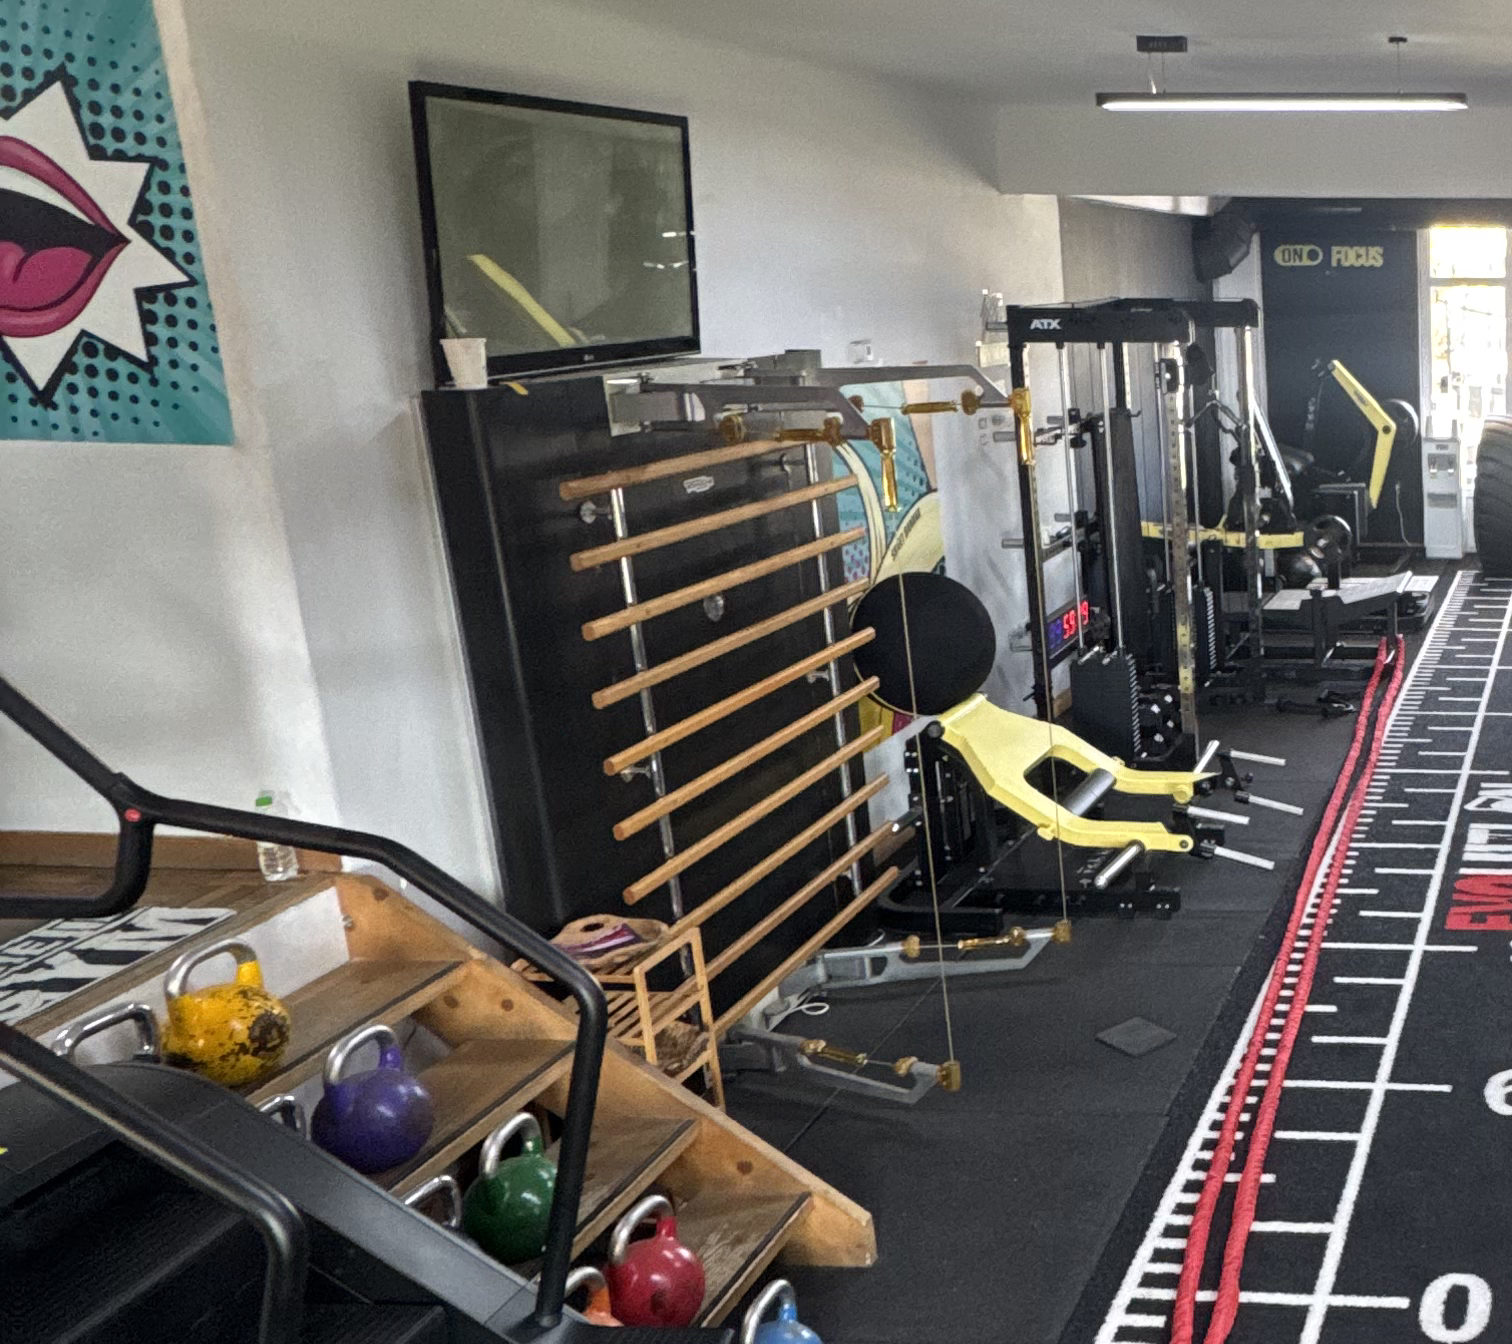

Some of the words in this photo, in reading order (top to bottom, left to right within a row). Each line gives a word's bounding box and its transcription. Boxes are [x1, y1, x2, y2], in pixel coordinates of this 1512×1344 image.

[1281, 247, 1304, 264] ON
[1330, 245, 1384, 268] FOCUS
[1030, 318, 1062, 330] ATX
